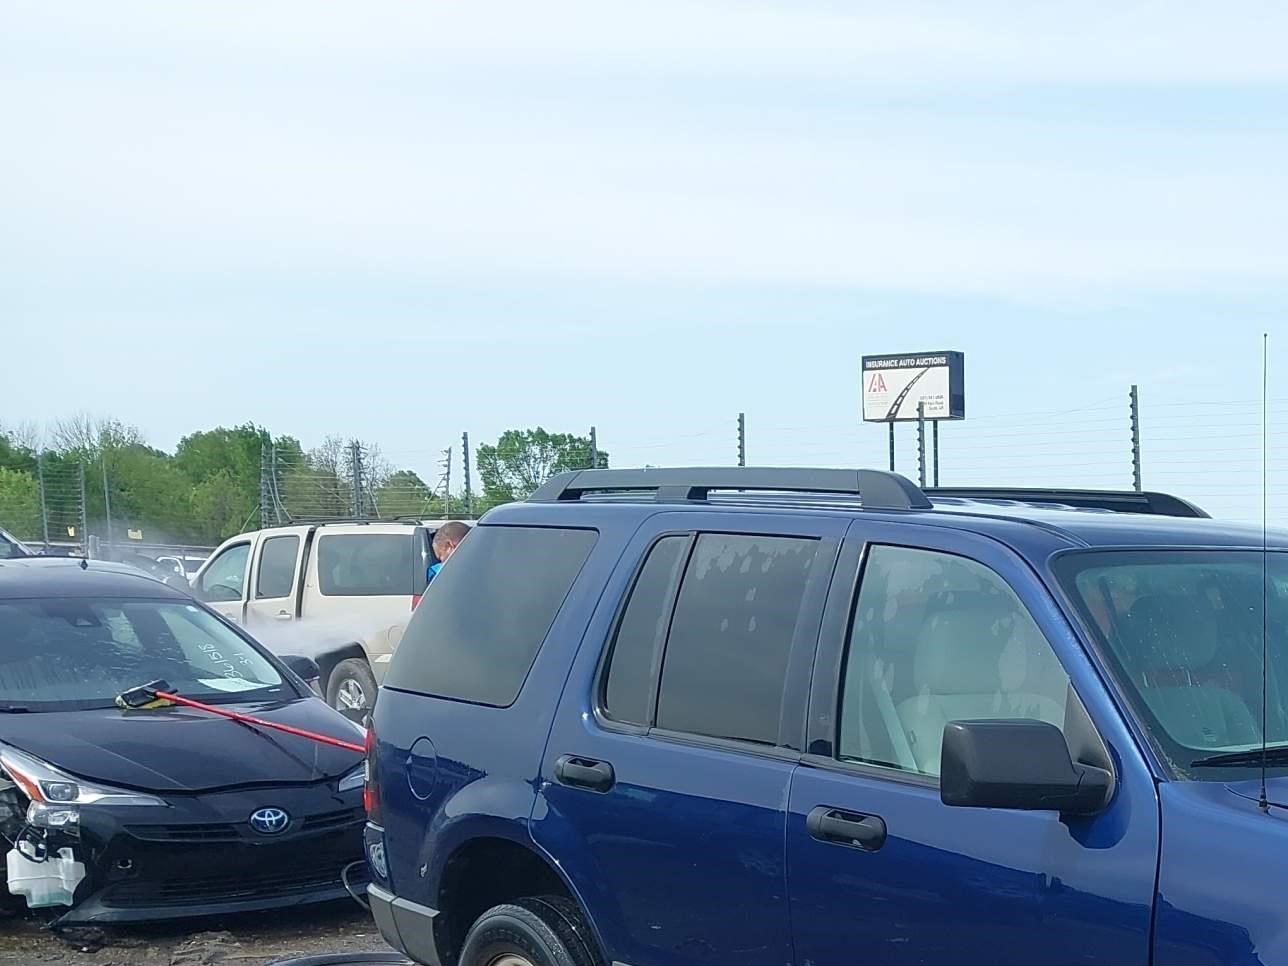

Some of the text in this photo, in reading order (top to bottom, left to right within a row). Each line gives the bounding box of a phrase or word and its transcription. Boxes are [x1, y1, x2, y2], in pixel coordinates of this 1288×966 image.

[865, 356, 947, 369] INSURANCE AUTO AUCTIONS
